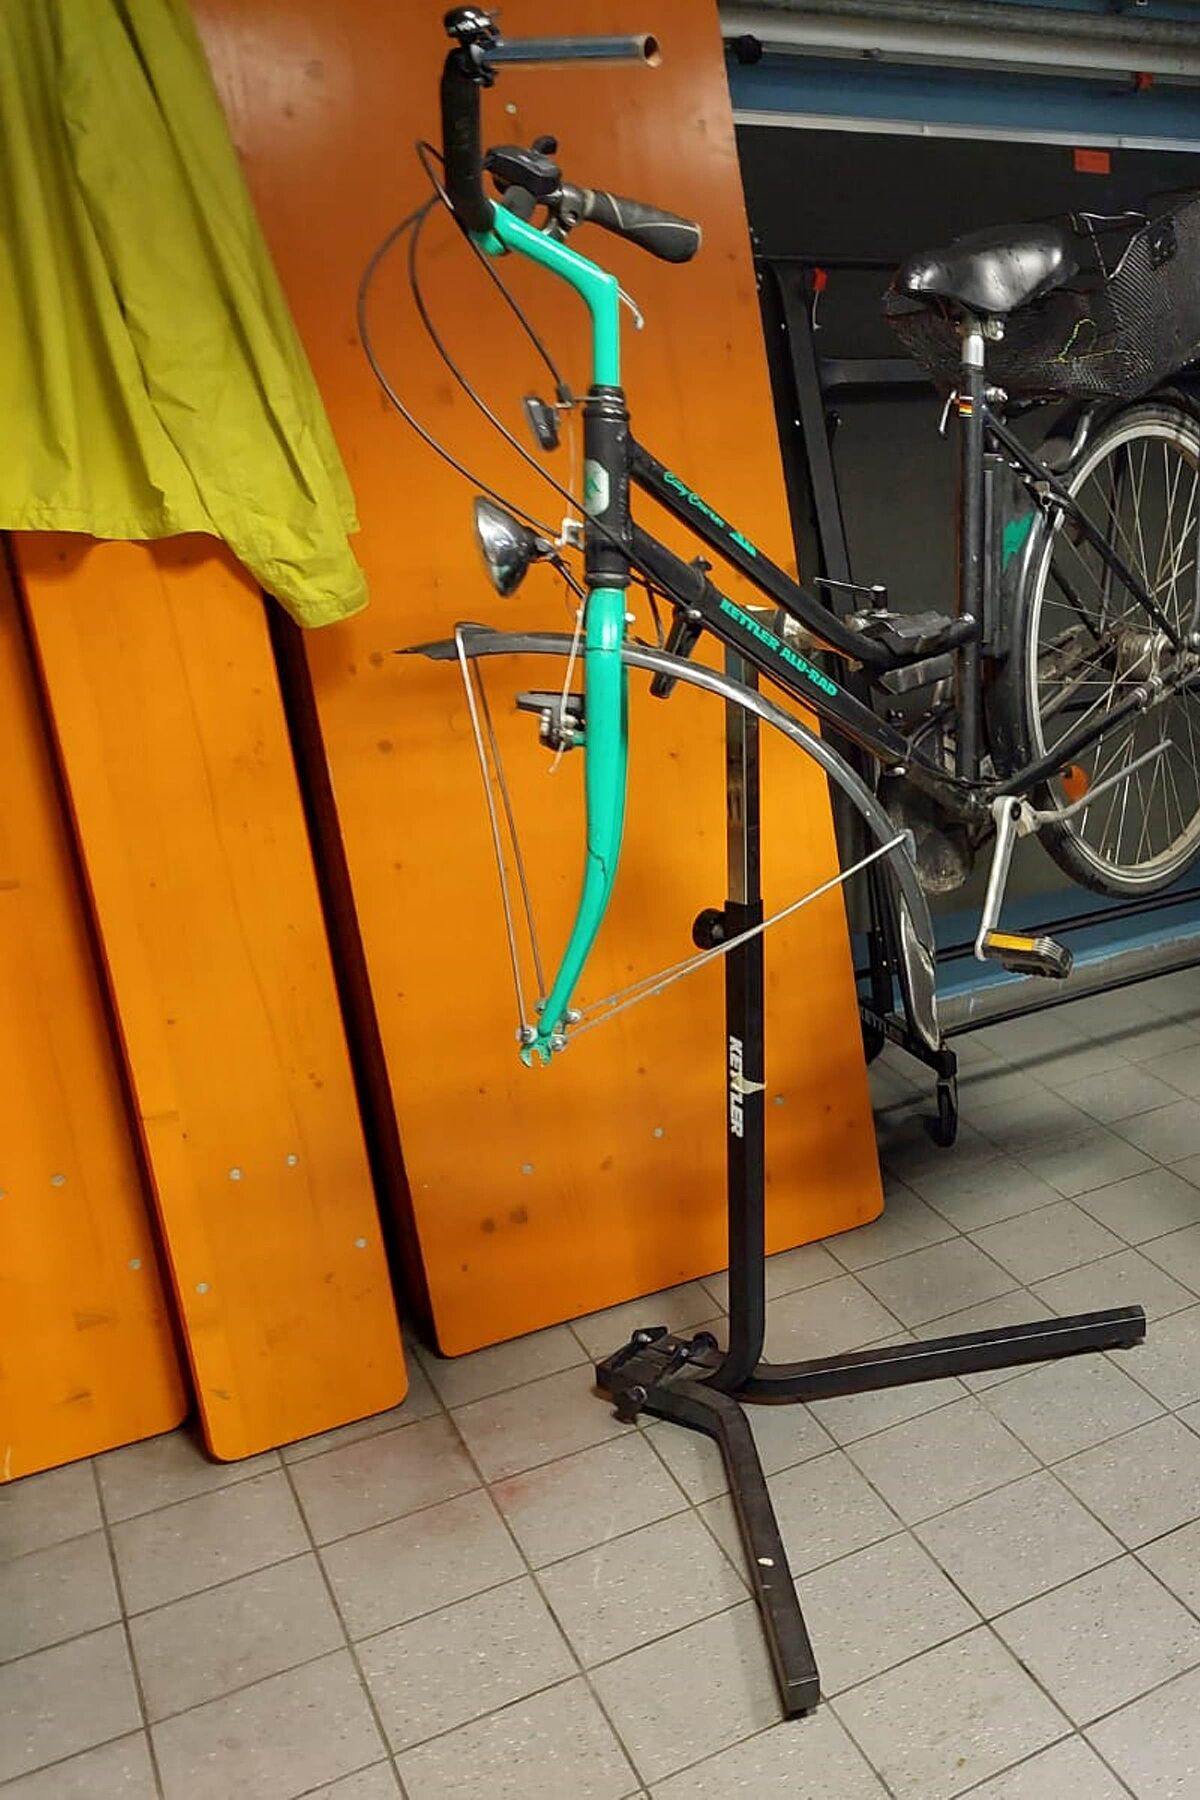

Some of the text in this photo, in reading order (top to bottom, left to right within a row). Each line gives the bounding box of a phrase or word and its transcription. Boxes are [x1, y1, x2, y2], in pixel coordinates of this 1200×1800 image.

[720, 598, 838, 696] KETTLER ALU-RAD
[729, 1034, 744, 1138] KETLER
